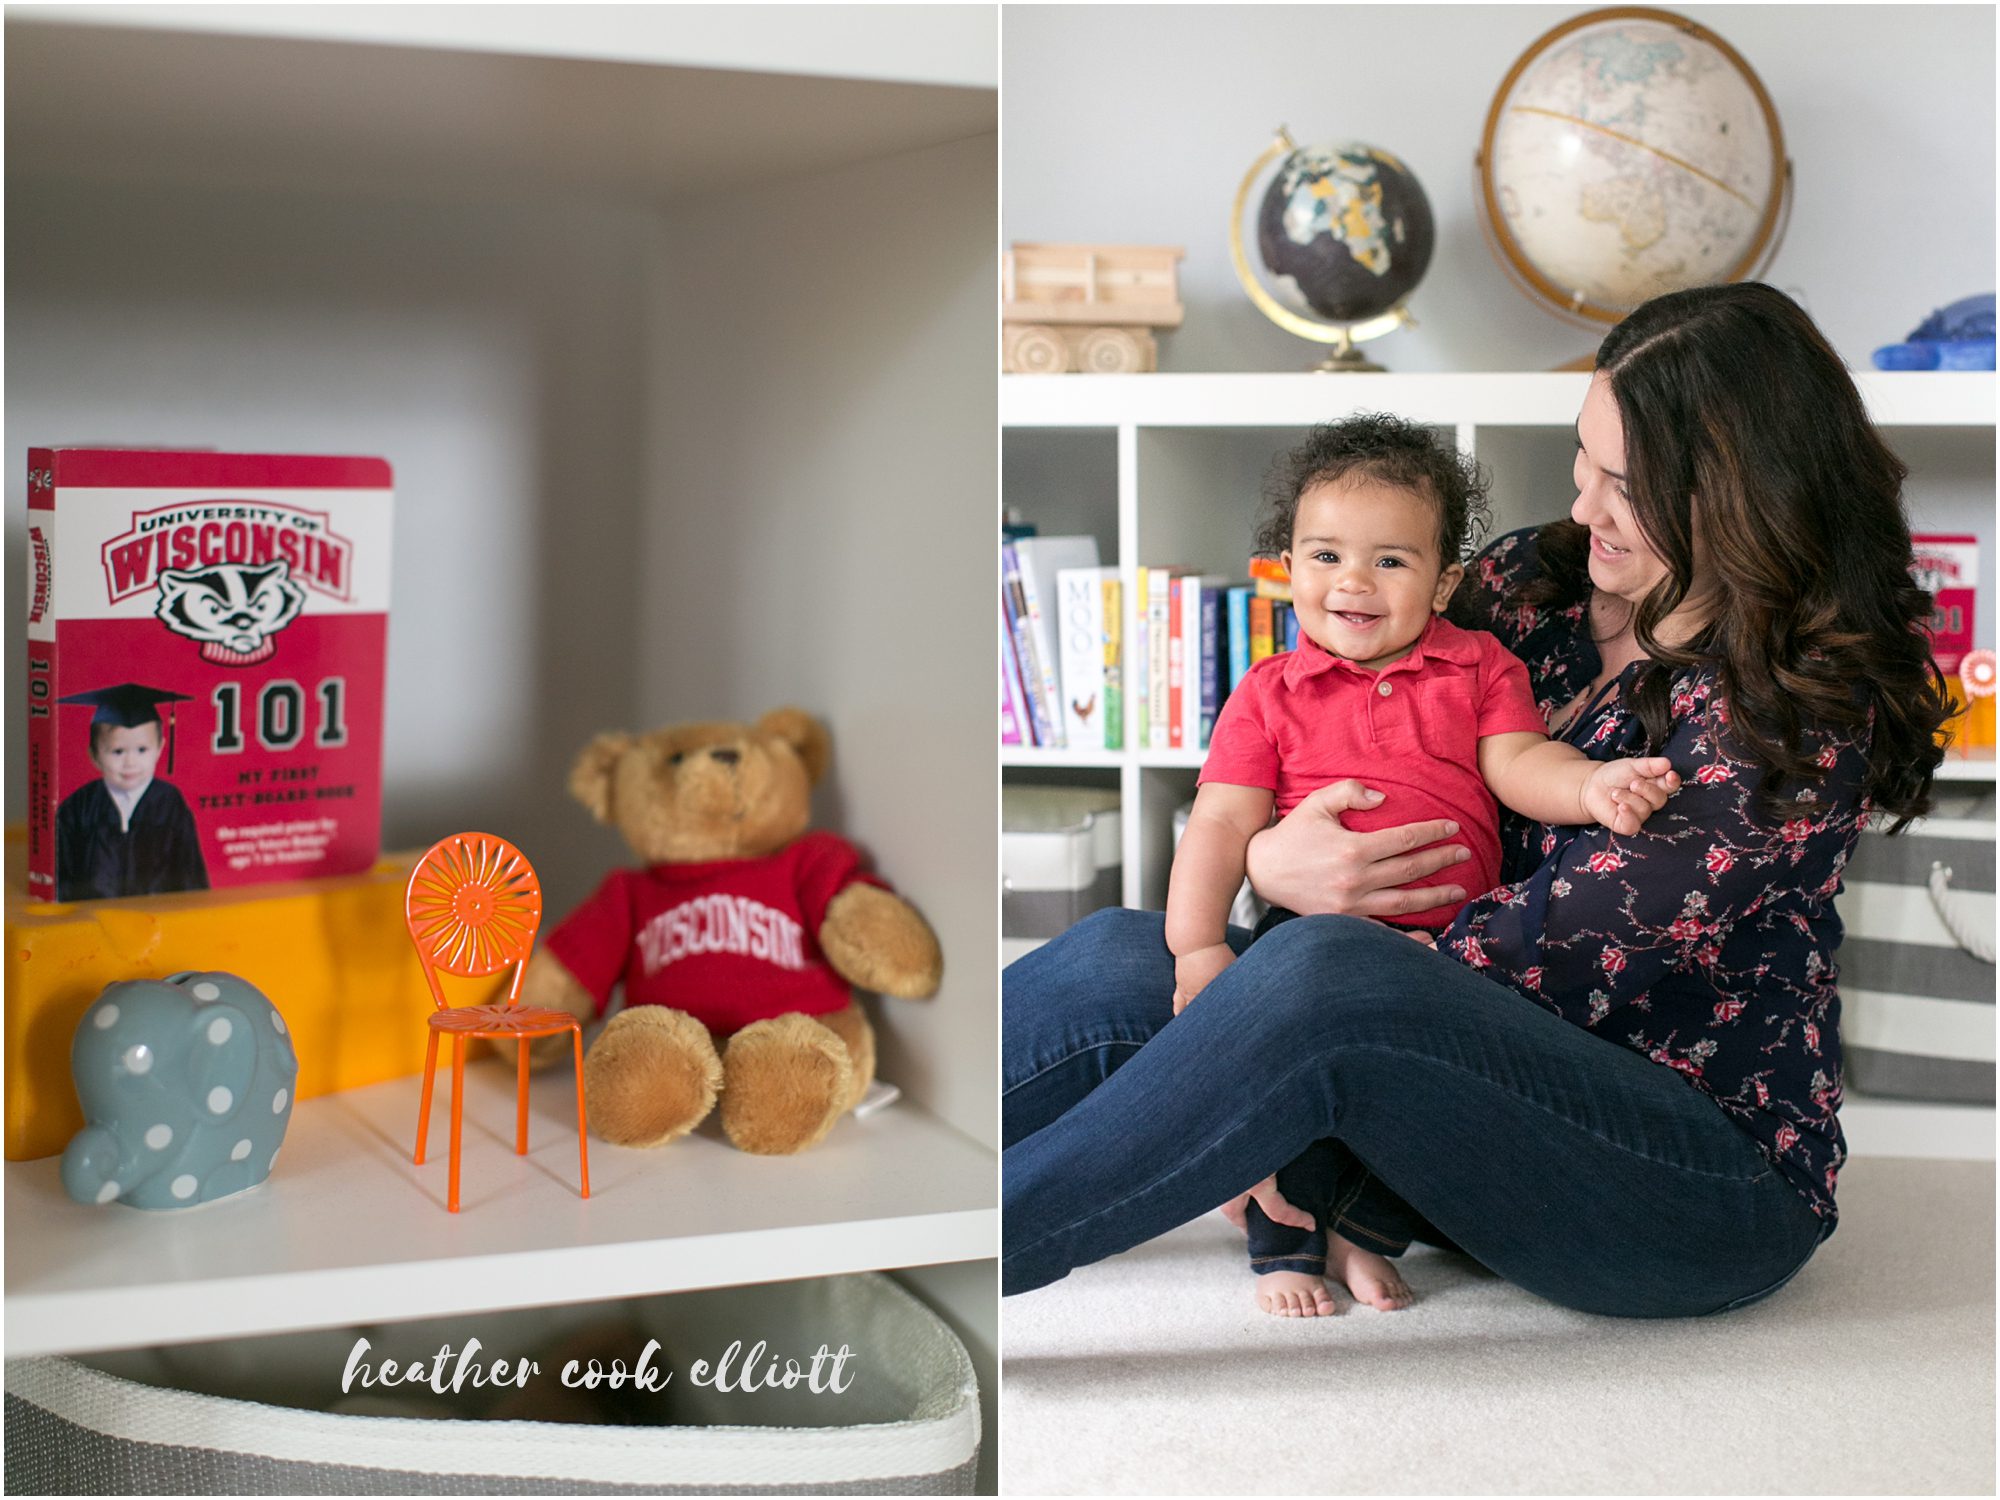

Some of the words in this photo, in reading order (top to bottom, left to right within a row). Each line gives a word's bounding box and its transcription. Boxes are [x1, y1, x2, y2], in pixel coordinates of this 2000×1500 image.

[140, 507, 285, 533] UNIVERSITY
[291, 516, 320, 531] OF
[28, 526, 48, 624] WISCONSIN
[110, 521, 343, 595] WISCONSIN
[31, 659, 49, 719] 101
[212, 678, 347, 754] 101
[239, 770, 262, 784] MY
[272, 766, 319, 781] FIRST
[636, 893, 804, 977] WISCONSIN
